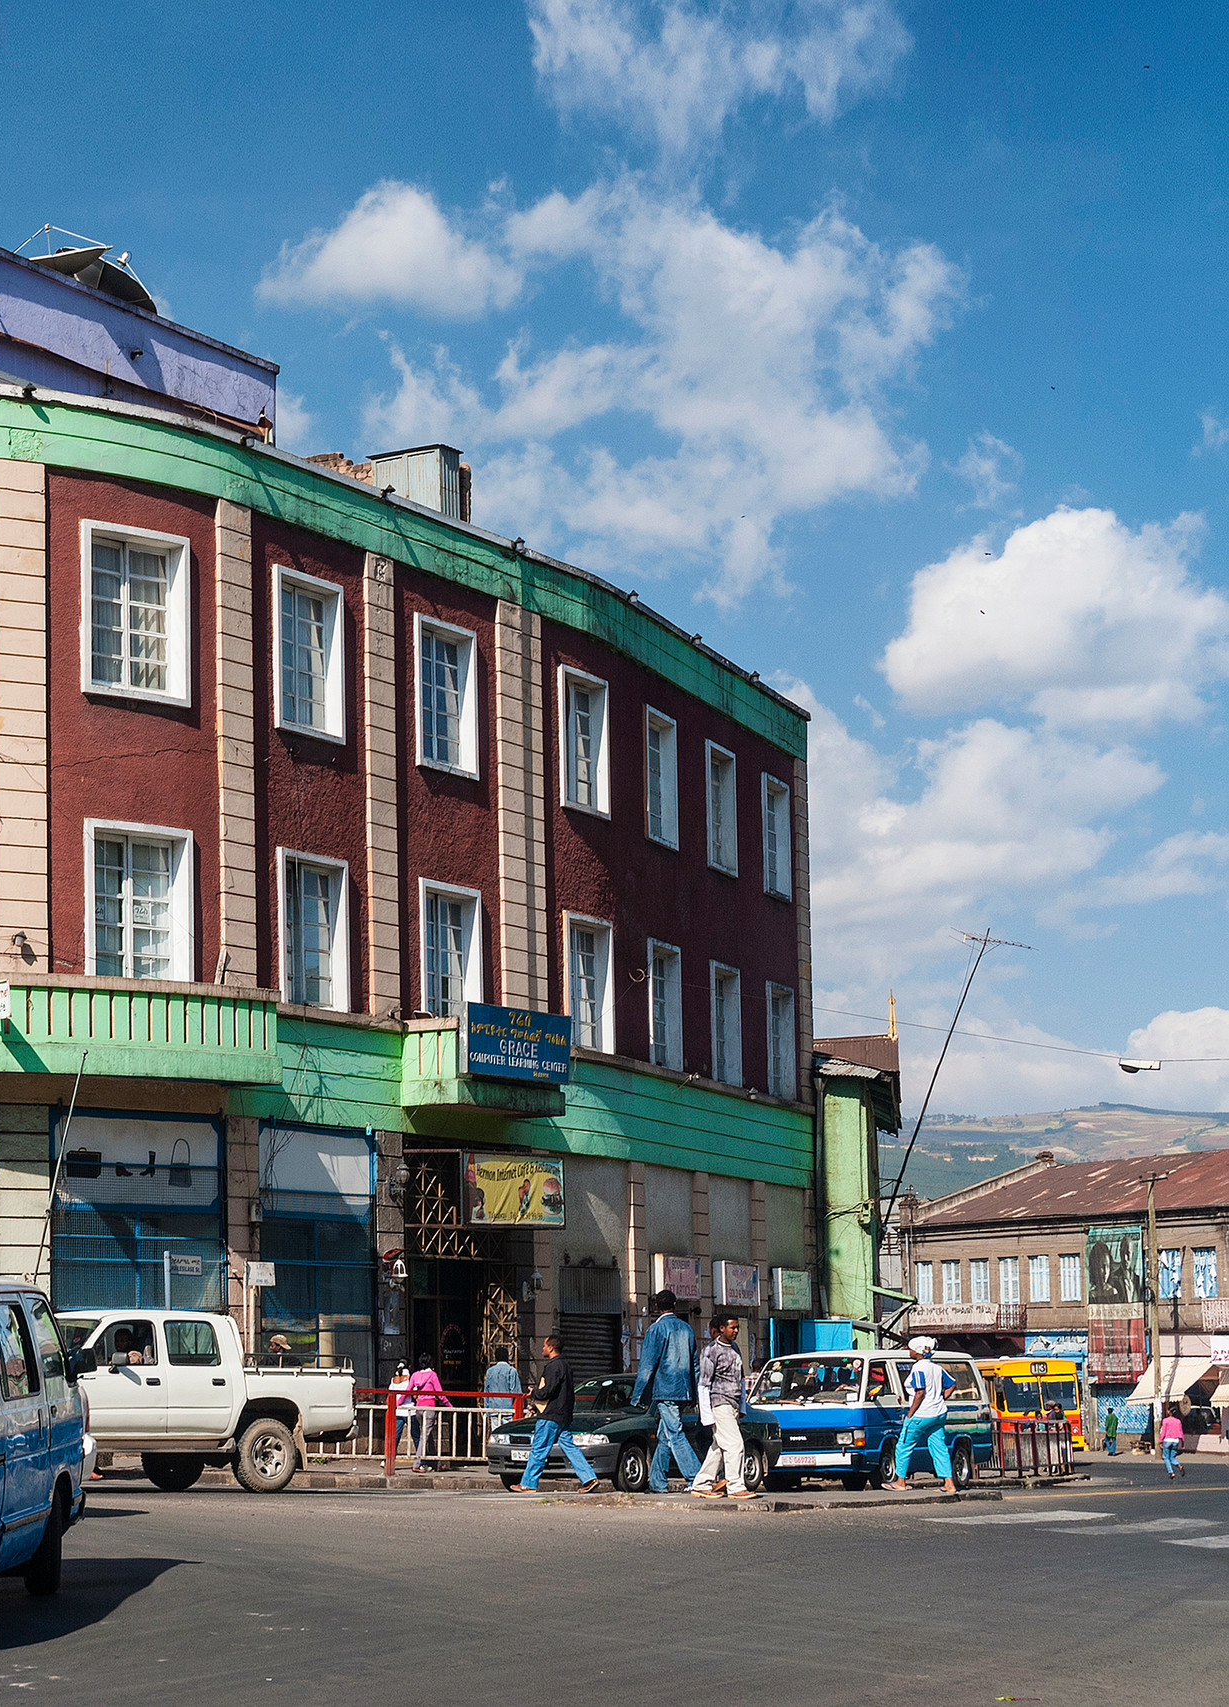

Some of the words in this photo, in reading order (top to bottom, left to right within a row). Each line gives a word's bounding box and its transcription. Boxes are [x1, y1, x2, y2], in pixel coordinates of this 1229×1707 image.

[499, 1039, 539, 1059] GRACE
[469, 1051, 506, 1066] COMPUTER
[508, 1056, 540, 1070] LEARNING
[541, 1060, 568, 1073] CENTER
[496, 1165, 517, 1182] Internet
[1032, 1363, 1047, 1373] 13
